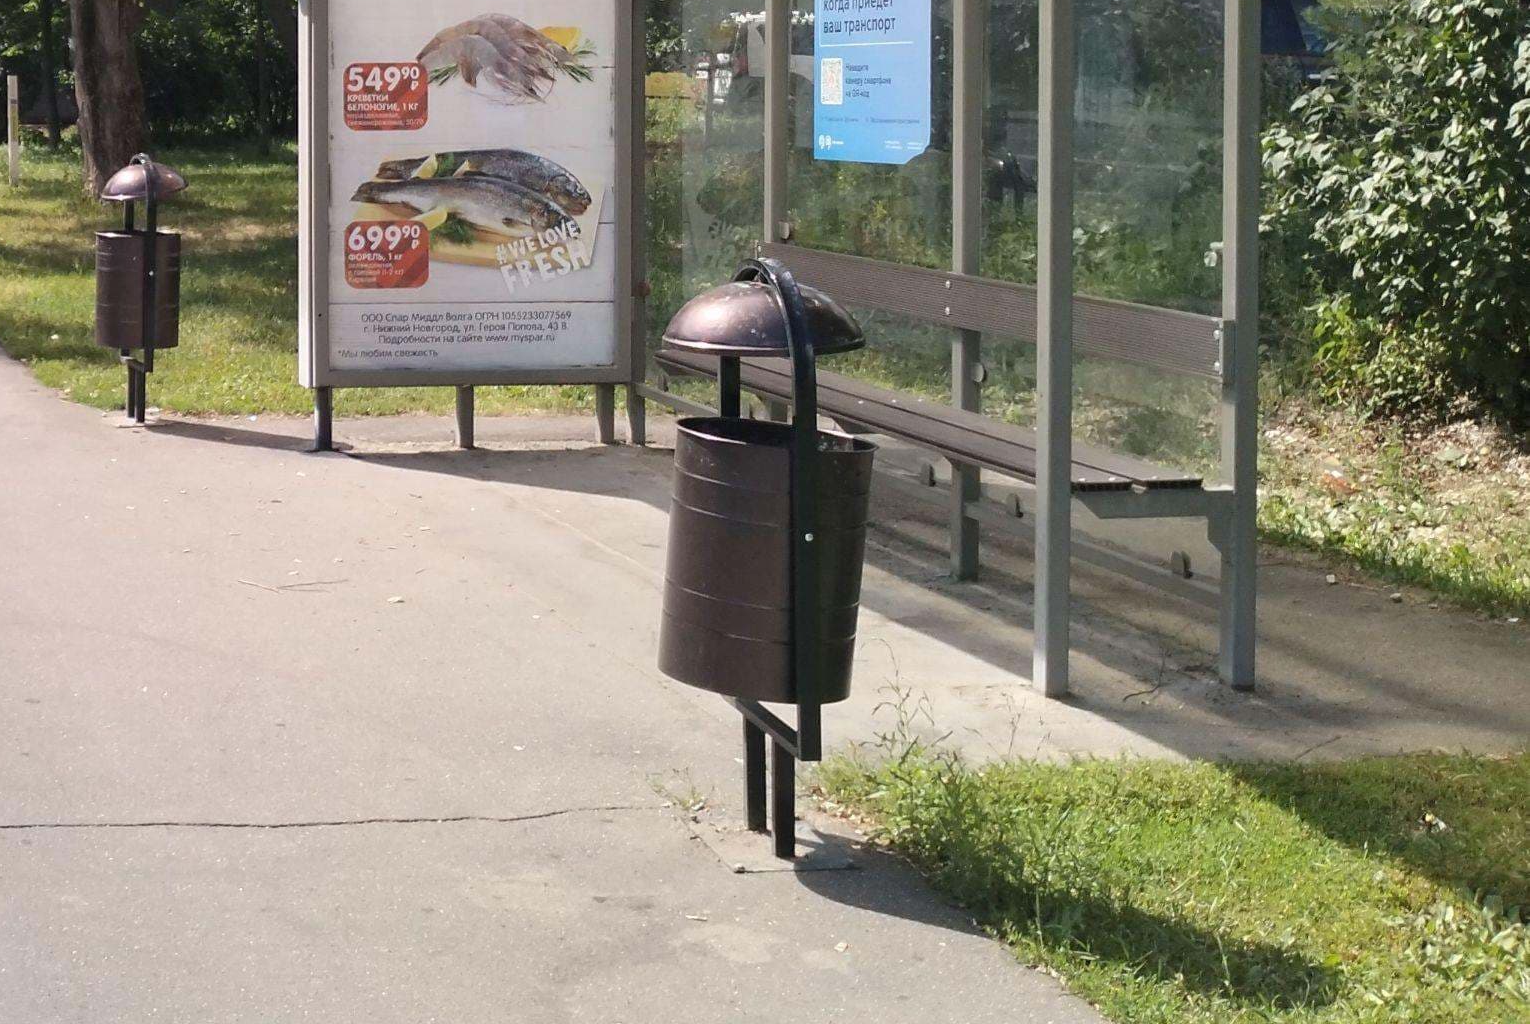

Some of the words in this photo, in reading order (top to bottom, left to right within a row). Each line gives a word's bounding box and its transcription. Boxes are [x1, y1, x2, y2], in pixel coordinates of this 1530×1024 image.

[823, 21, 842, 34] ваш
[844, 17, 896, 36] транспорт
[347, 66, 401, 92] 549
[401, 66, 420, 79] 90
[347, 94, 389, 102] КРЕВЕТКИ
[348, 225, 402, 251] 699
[402, 225, 420, 238] 90
[537, 219, 580, 249] LOVE
[348, 253, 386, 261] ФОРЕЛЬ,
[500, 240, 591, 293] FRESH
[361, 313, 383, 323] ООО
[385, 313, 409, 324] Спар
[411, 313, 443, 323] Миддл
[445, 312, 473, 321] Волга
[475, 311, 499, 321] ОГРН
[373, 324, 410, 333] Нижний
[413, 325, 461, 334] Новгород,
[479, 322, 505, 332] Героя
[508, 322, 545, 332] Попова,
[547, 322, 559, 330] 43
[378, 335, 441, 345] Подробности
[457, 335, 483, 343] сайте
[486, 335, 555, 344] www.myspar.ru
[361, 349, 392, 357] любим
[394, 349, 438, 357] свежесть
